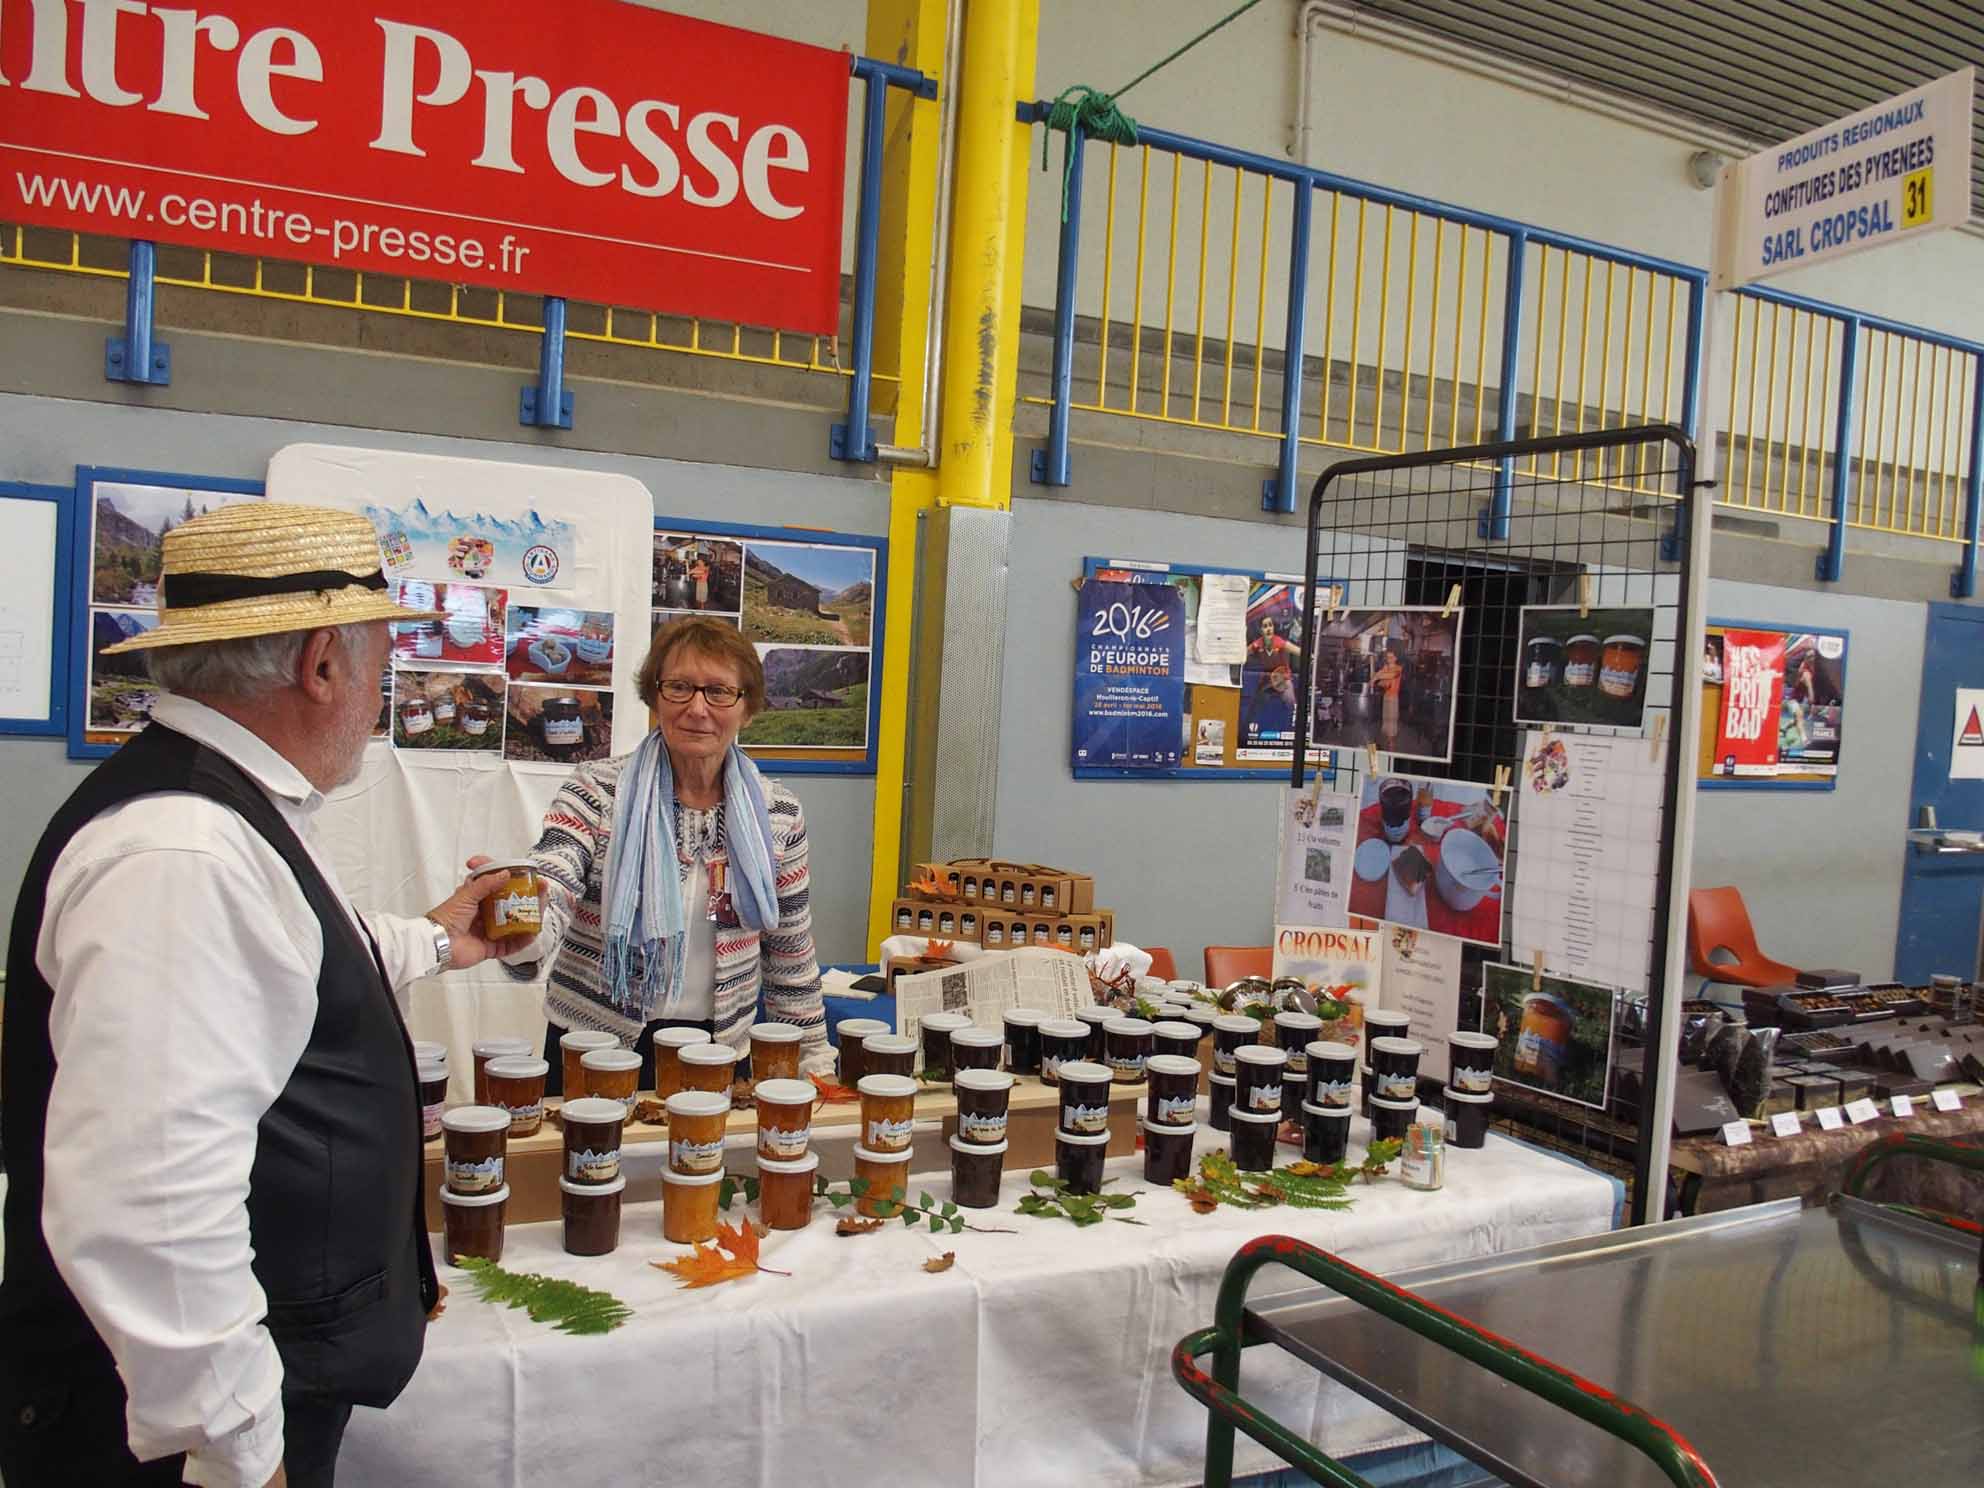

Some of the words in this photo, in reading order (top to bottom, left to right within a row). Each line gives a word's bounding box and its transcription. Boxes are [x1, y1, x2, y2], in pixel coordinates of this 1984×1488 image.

[368, 18, 810, 220] Presse
[1778, 133, 1839, 172] PRODUITS
[1842, 100, 1924, 148] REGIONAUX
[1764, 173, 1835, 219] CONFITURES
[1839, 162, 1861, 199] DES
[1865, 136, 1934, 185] PYRENEES
[1907, 176, 1927, 219] 31
[16, 172, 531, 275] www.centre-presse.fr
[1762, 227, 1804, 266] SARL
[1810, 199, 1893, 253] CROPSAL
[1092, 602, 1157, 643] 2016
[1090, 650, 1169, 666] D'EUROPE
[1090, 664, 1103, 673] DE
[1106, 664, 1169, 676] BADMINTON
[1725, 706, 1761, 741] BAD
[1279, 929, 1375, 961] CROPSAL
